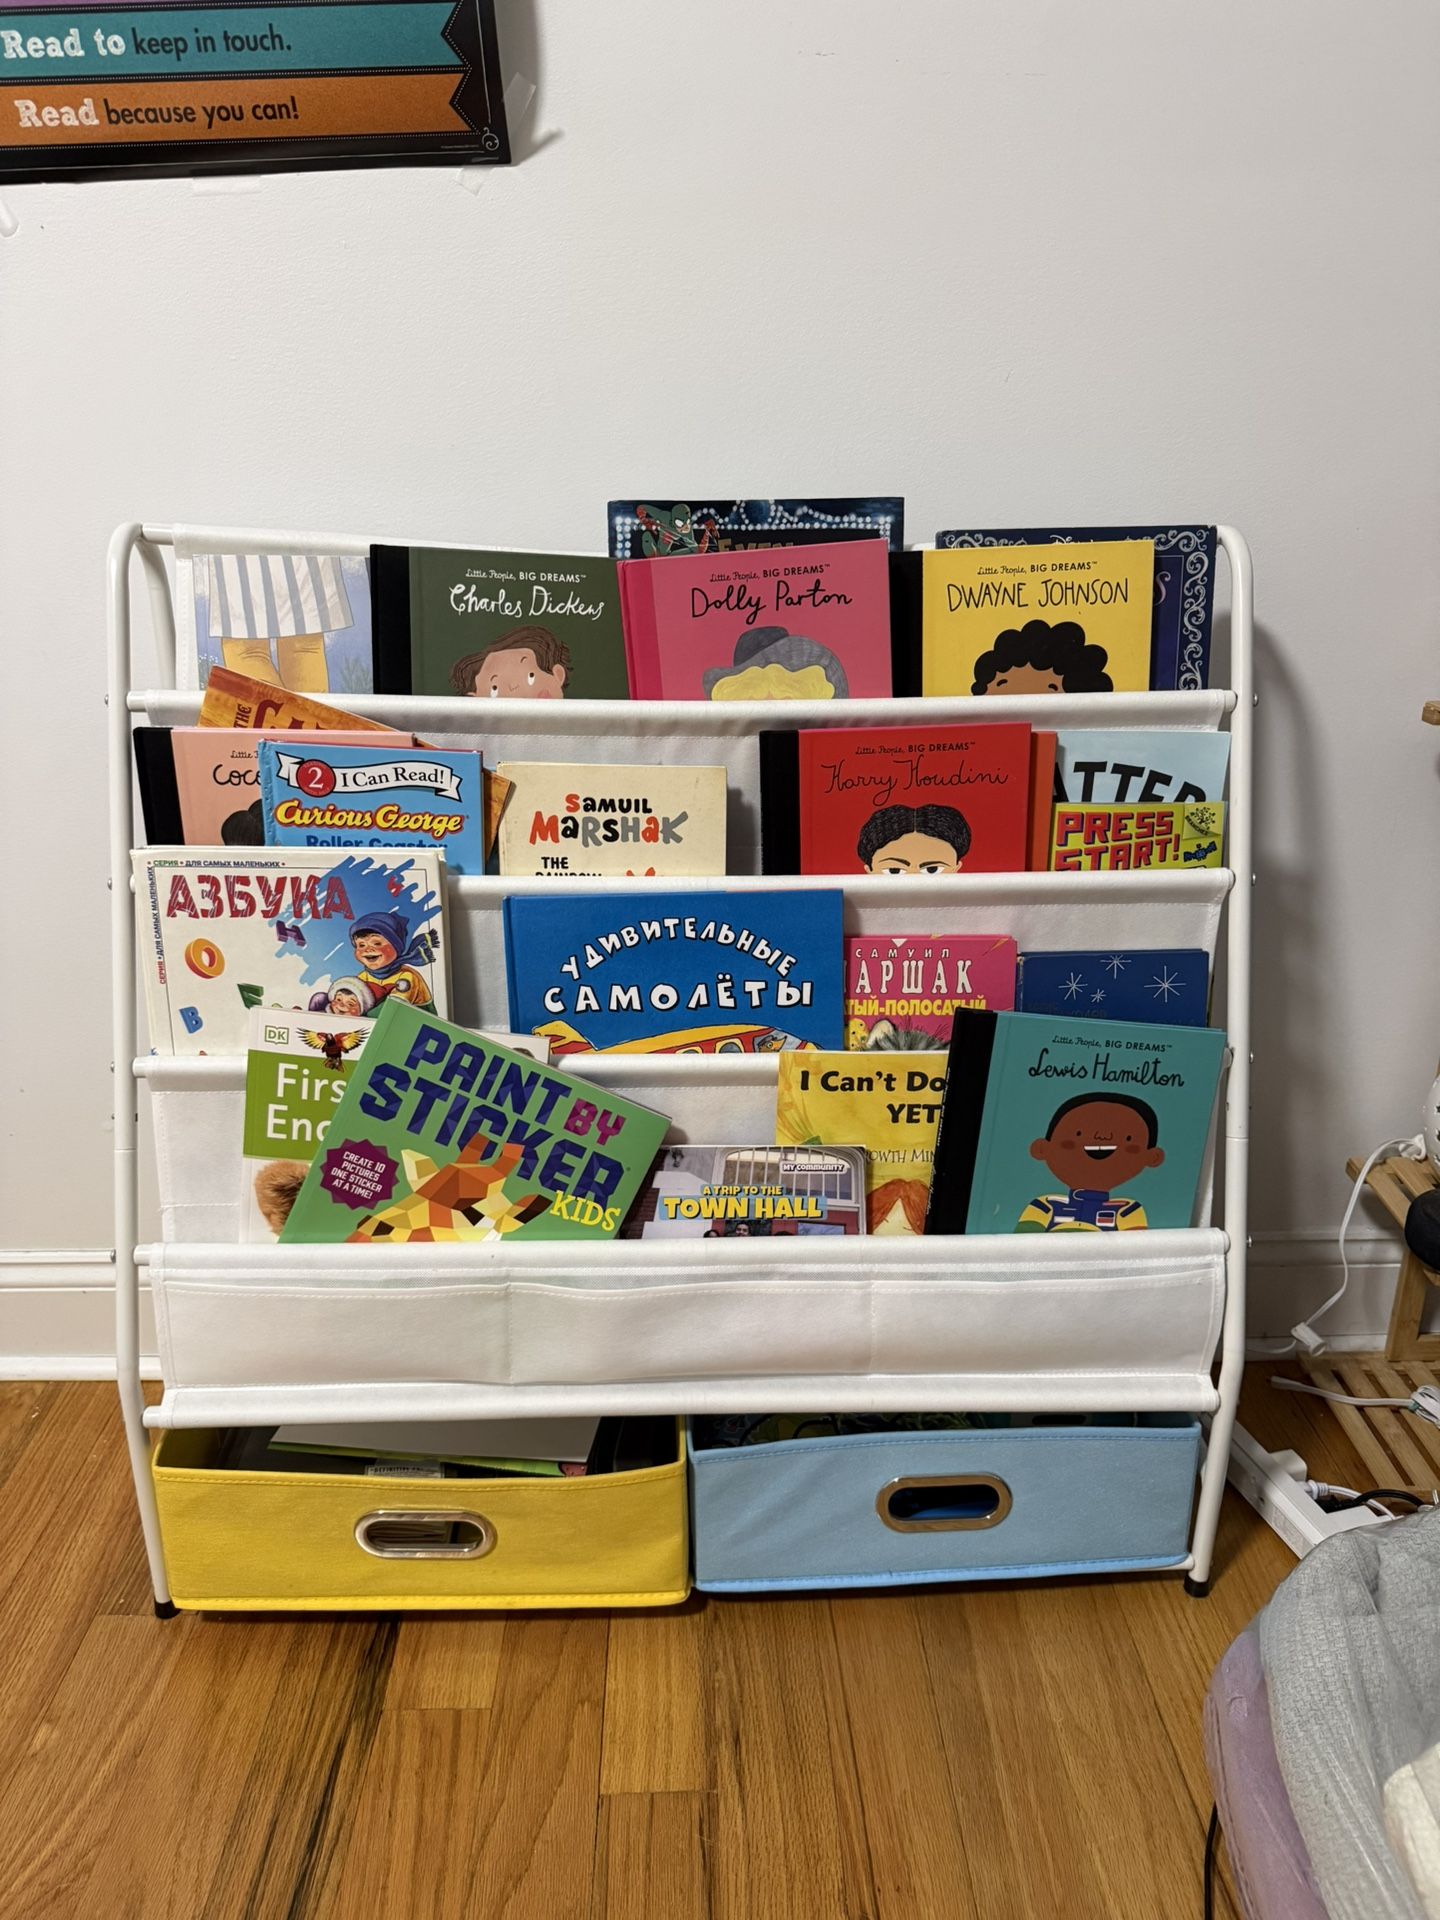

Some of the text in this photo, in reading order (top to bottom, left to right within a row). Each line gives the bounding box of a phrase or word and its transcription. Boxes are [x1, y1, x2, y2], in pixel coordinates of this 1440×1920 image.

[0, 23, 292, 61] Read to keep in touch.
[14, 96, 299, 128] Read because you can!
[466, 568, 487, 578] Little
[519, 571, 537, 581] BIG
[710, 572, 731, 582] Little
[763, 569, 780, 578] BIG
[977, 566, 998, 576] Little
[1030, 563, 1047, 573] BIG
[449, 584, 605, 620] Charles Dickens
[692, 579, 852, 625] Dolly Parton
[947, 581, 1028, 612] DWAYNE
[1038, 578, 1128, 606] JOHNSON
[855, 745, 876, 755] Little
[908, 743, 925, 753] BIG
[307, 766, 324, 789] 2
[342, 773, 349, 787] I
[353, 771, 389, 787] Can
[392, 767, 445, 784] Read!
[821, 754, 1009, 806] Harry Houdini
[275, 800, 463, 839] Curious George
[1056, 811, 1174, 847] PRESS
[541, 856, 569, 870] THE
[1055, 833, 1180, 871] START!
[185, 860, 202, 868] ДЛЯ
[166, 874, 355, 920] АЗБУКА
[153, 913, 162, 940] САМЫХ
[156, 940, 164, 957] ДЛЯ
[561, 917, 798, 981] УДИВИТЕЛЬНЫЕ
[855, 948, 950, 958] САМУИЛ
[844, 960, 972, 993] АРШАК
[544, 973, 813, 1013] САМОЛЁТЫ
[267, 1031, 286, 1041] DK
[1052, 1035, 1073, 1045] Little
[1105, 1040, 1122, 1049] BIG
[1028, 1048, 1184, 1087] Lewis Hamilton
[404, 1024, 626, 1146] PAINT BY
[800, 1070, 948, 1092] I Can't Do
[886, 1104, 942, 1124] YET
[360, 1062, 624, 1209] STICKER
[341, 1161, 380, 1181] PICTURES
[343, 1151, 386, 1173] CREATE 10
[783, 1163, 796, 1172] MY
[331, 1167, 382, 1193] ONE STICKER
[332, 1179, 344, 1188] AT
[350, 1184, 373, 1199] TIME!
[703, 1186, 784, 1197] A TRIP TO THE
[550, 1190, 621, 1231] KIDS
[664, 1197, 823, 1220] TOWN HALL
